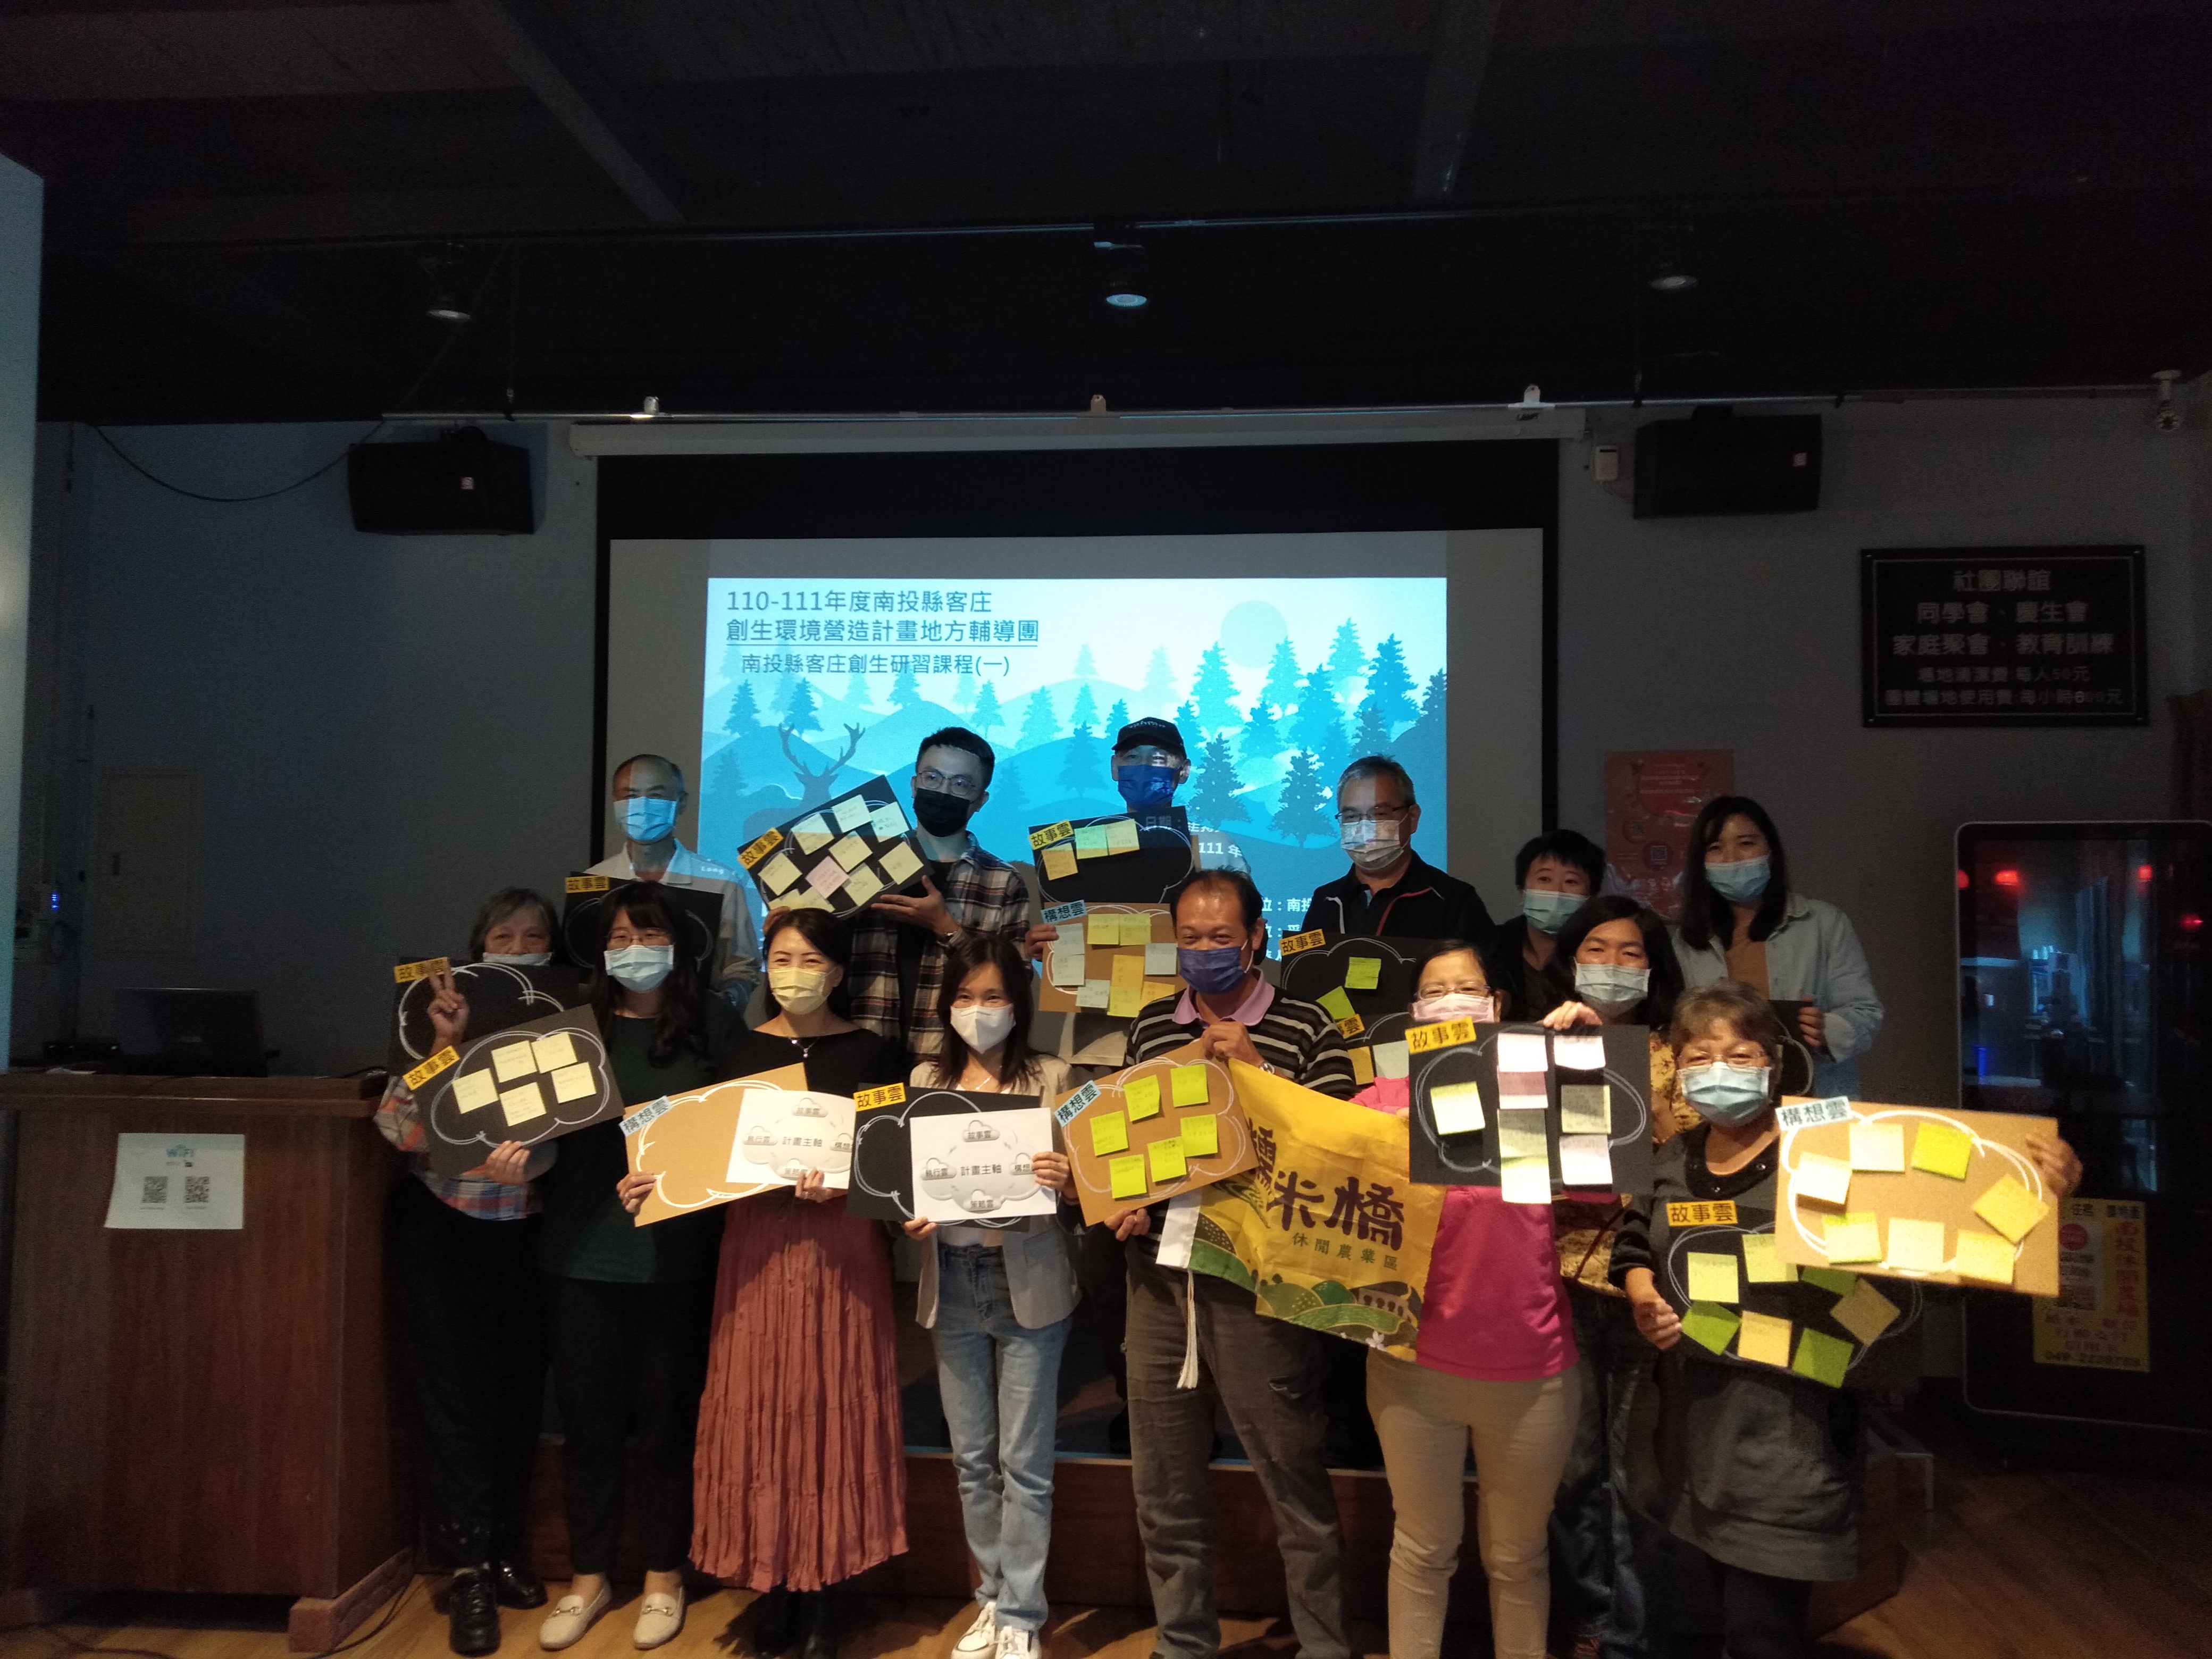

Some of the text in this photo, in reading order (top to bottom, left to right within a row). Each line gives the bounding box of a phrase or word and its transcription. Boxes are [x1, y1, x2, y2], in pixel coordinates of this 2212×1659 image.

[726, 590, 992, 613] 110-111年度南投縣客庄
[726, 619, 1039, 642] 創生環境營造計畫地方輔導團
[742, 653, 1010, 676] 南投縣客庄創生研習課程(一)
[1030, 824, 1071, 848] 故事雲
[1044, 902, 1084, 923] 構想雲
[1281, 932, 1323, 953] 故事雲
[1411, 1021, 1470, 1051] 故事雲
[407, 1049, 456, 1086] 故事雲
[856, 1084, 904, 1109] 故事雲
[1057, 1083, 1099, 1123] 構想雲
[623, 1097, 671, 1134] 構想雲
[1781, 1100, 1849, 1126] 構想雲
[1669, 1203, 1734, 1222] 故事雲
